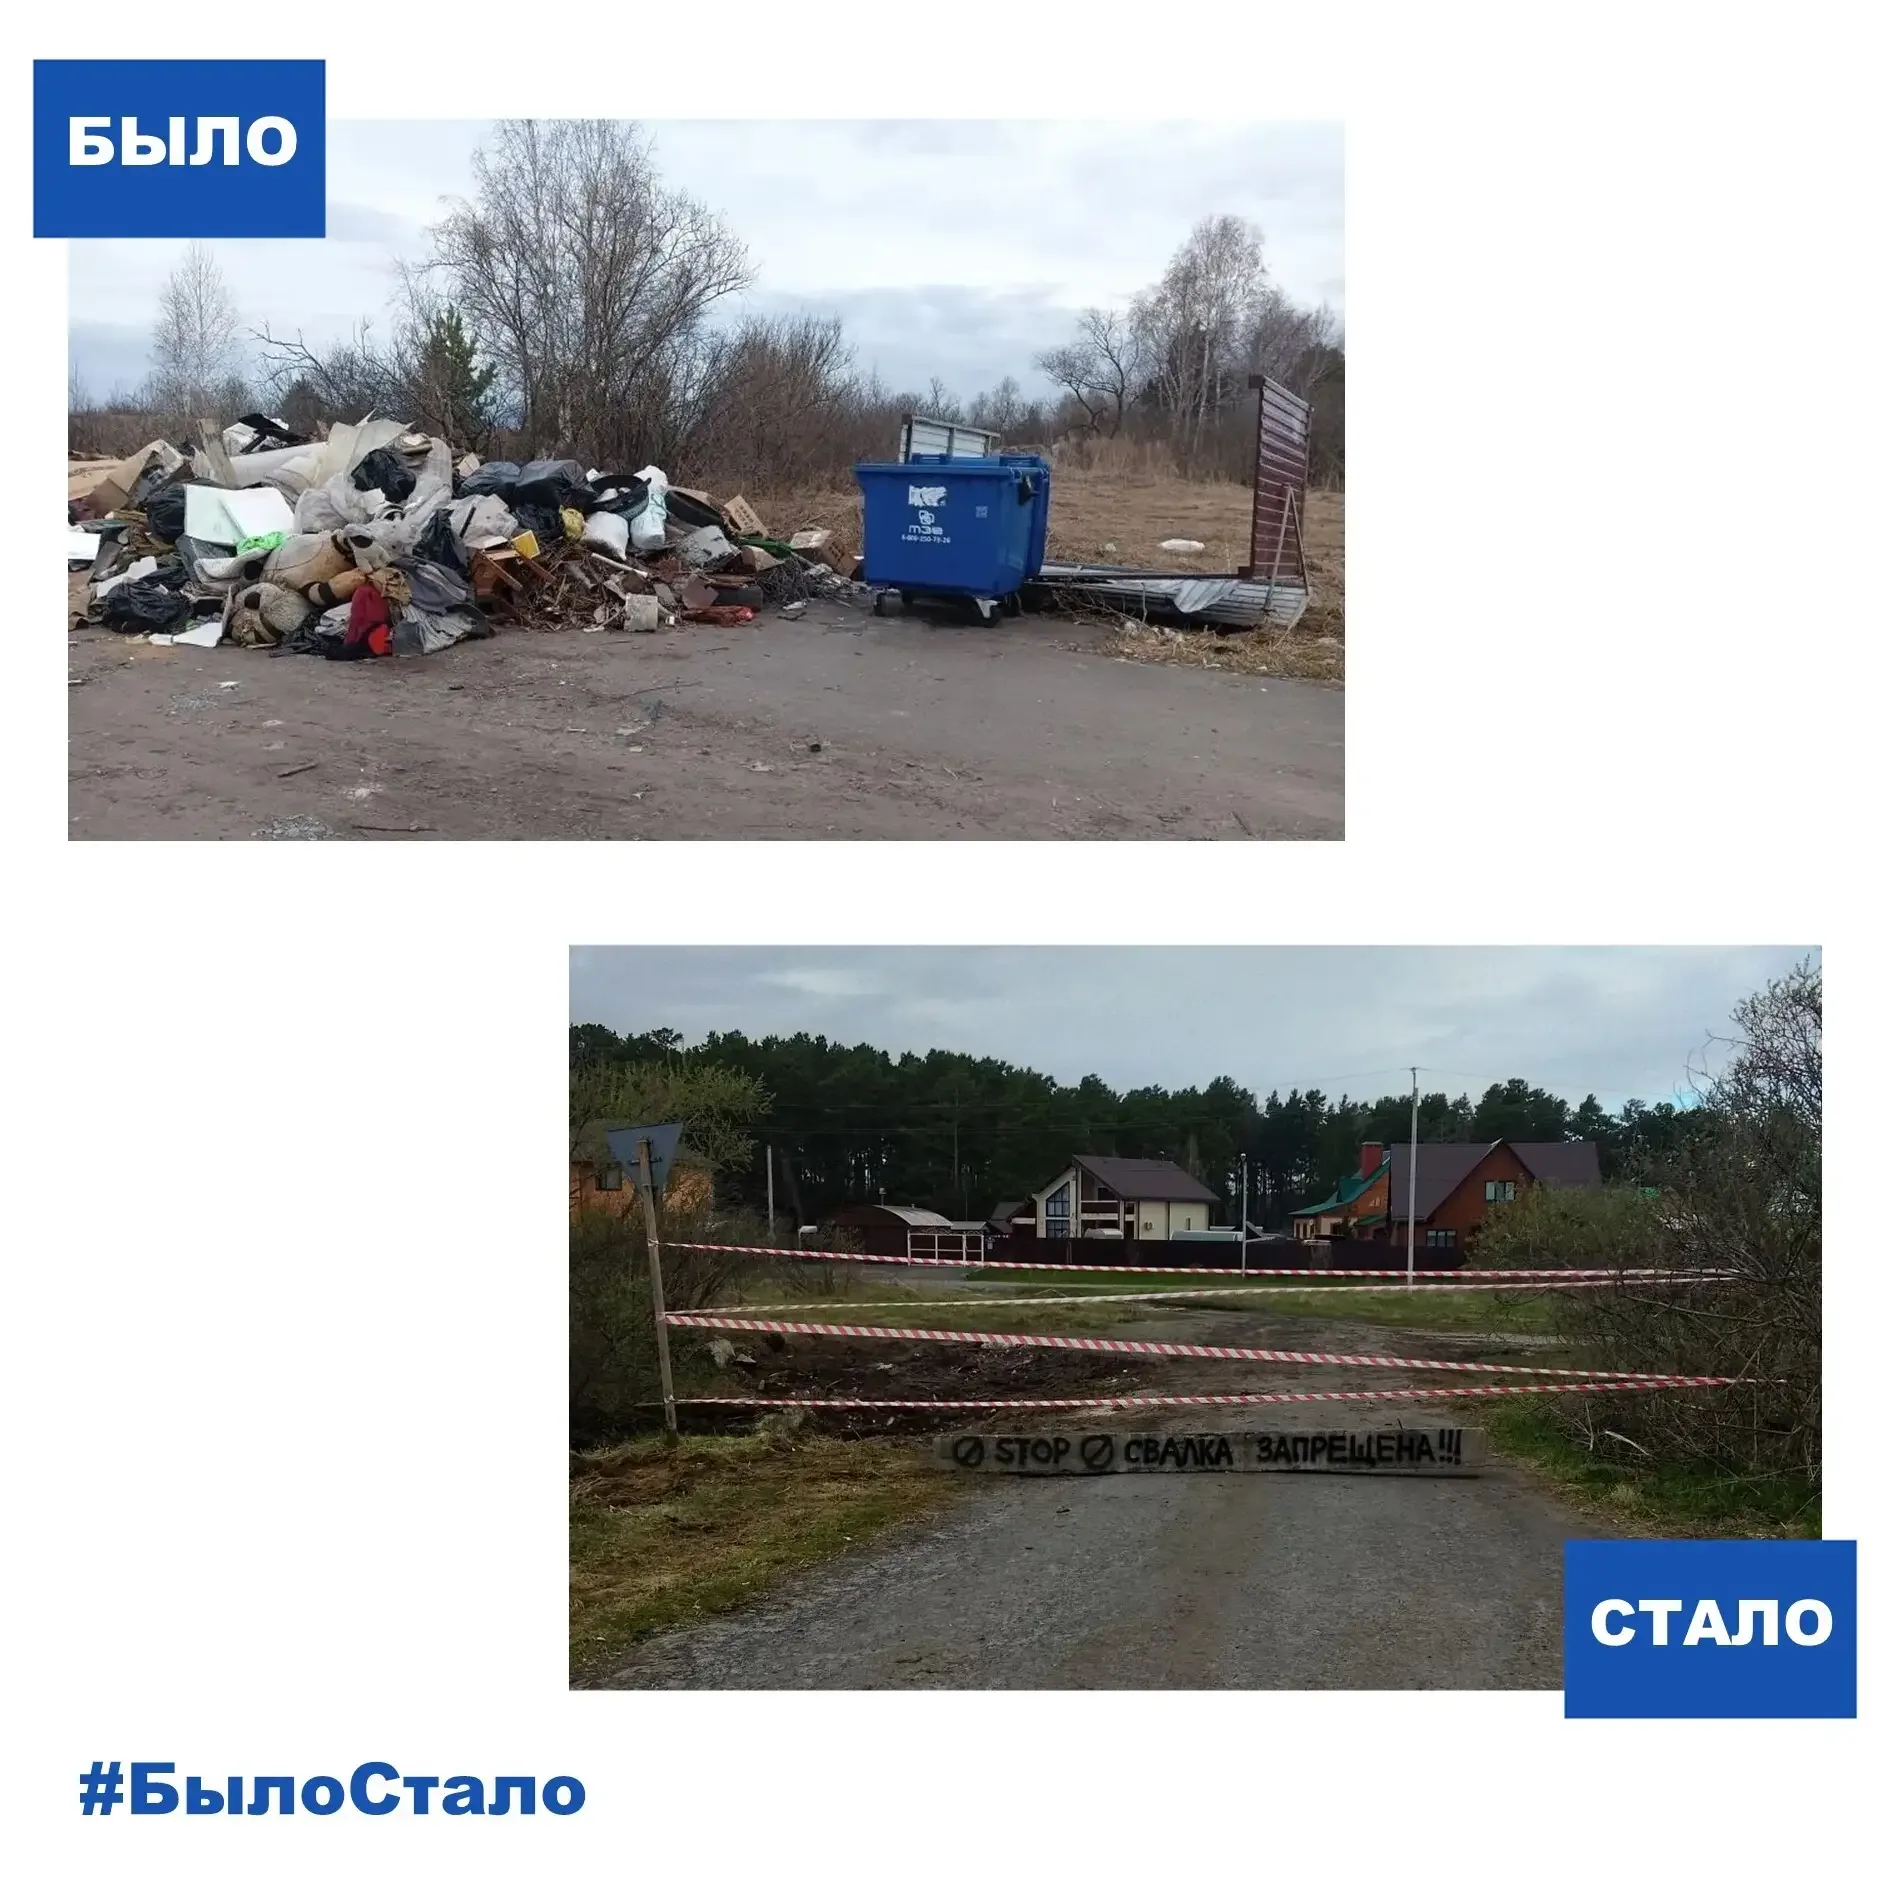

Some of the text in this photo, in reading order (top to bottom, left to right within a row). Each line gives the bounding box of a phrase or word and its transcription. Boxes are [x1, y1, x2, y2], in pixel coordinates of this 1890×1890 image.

[994, 1429, 1462, 1467] STOP СВАЛКА ЗАПРЕЩЕНА!!!
